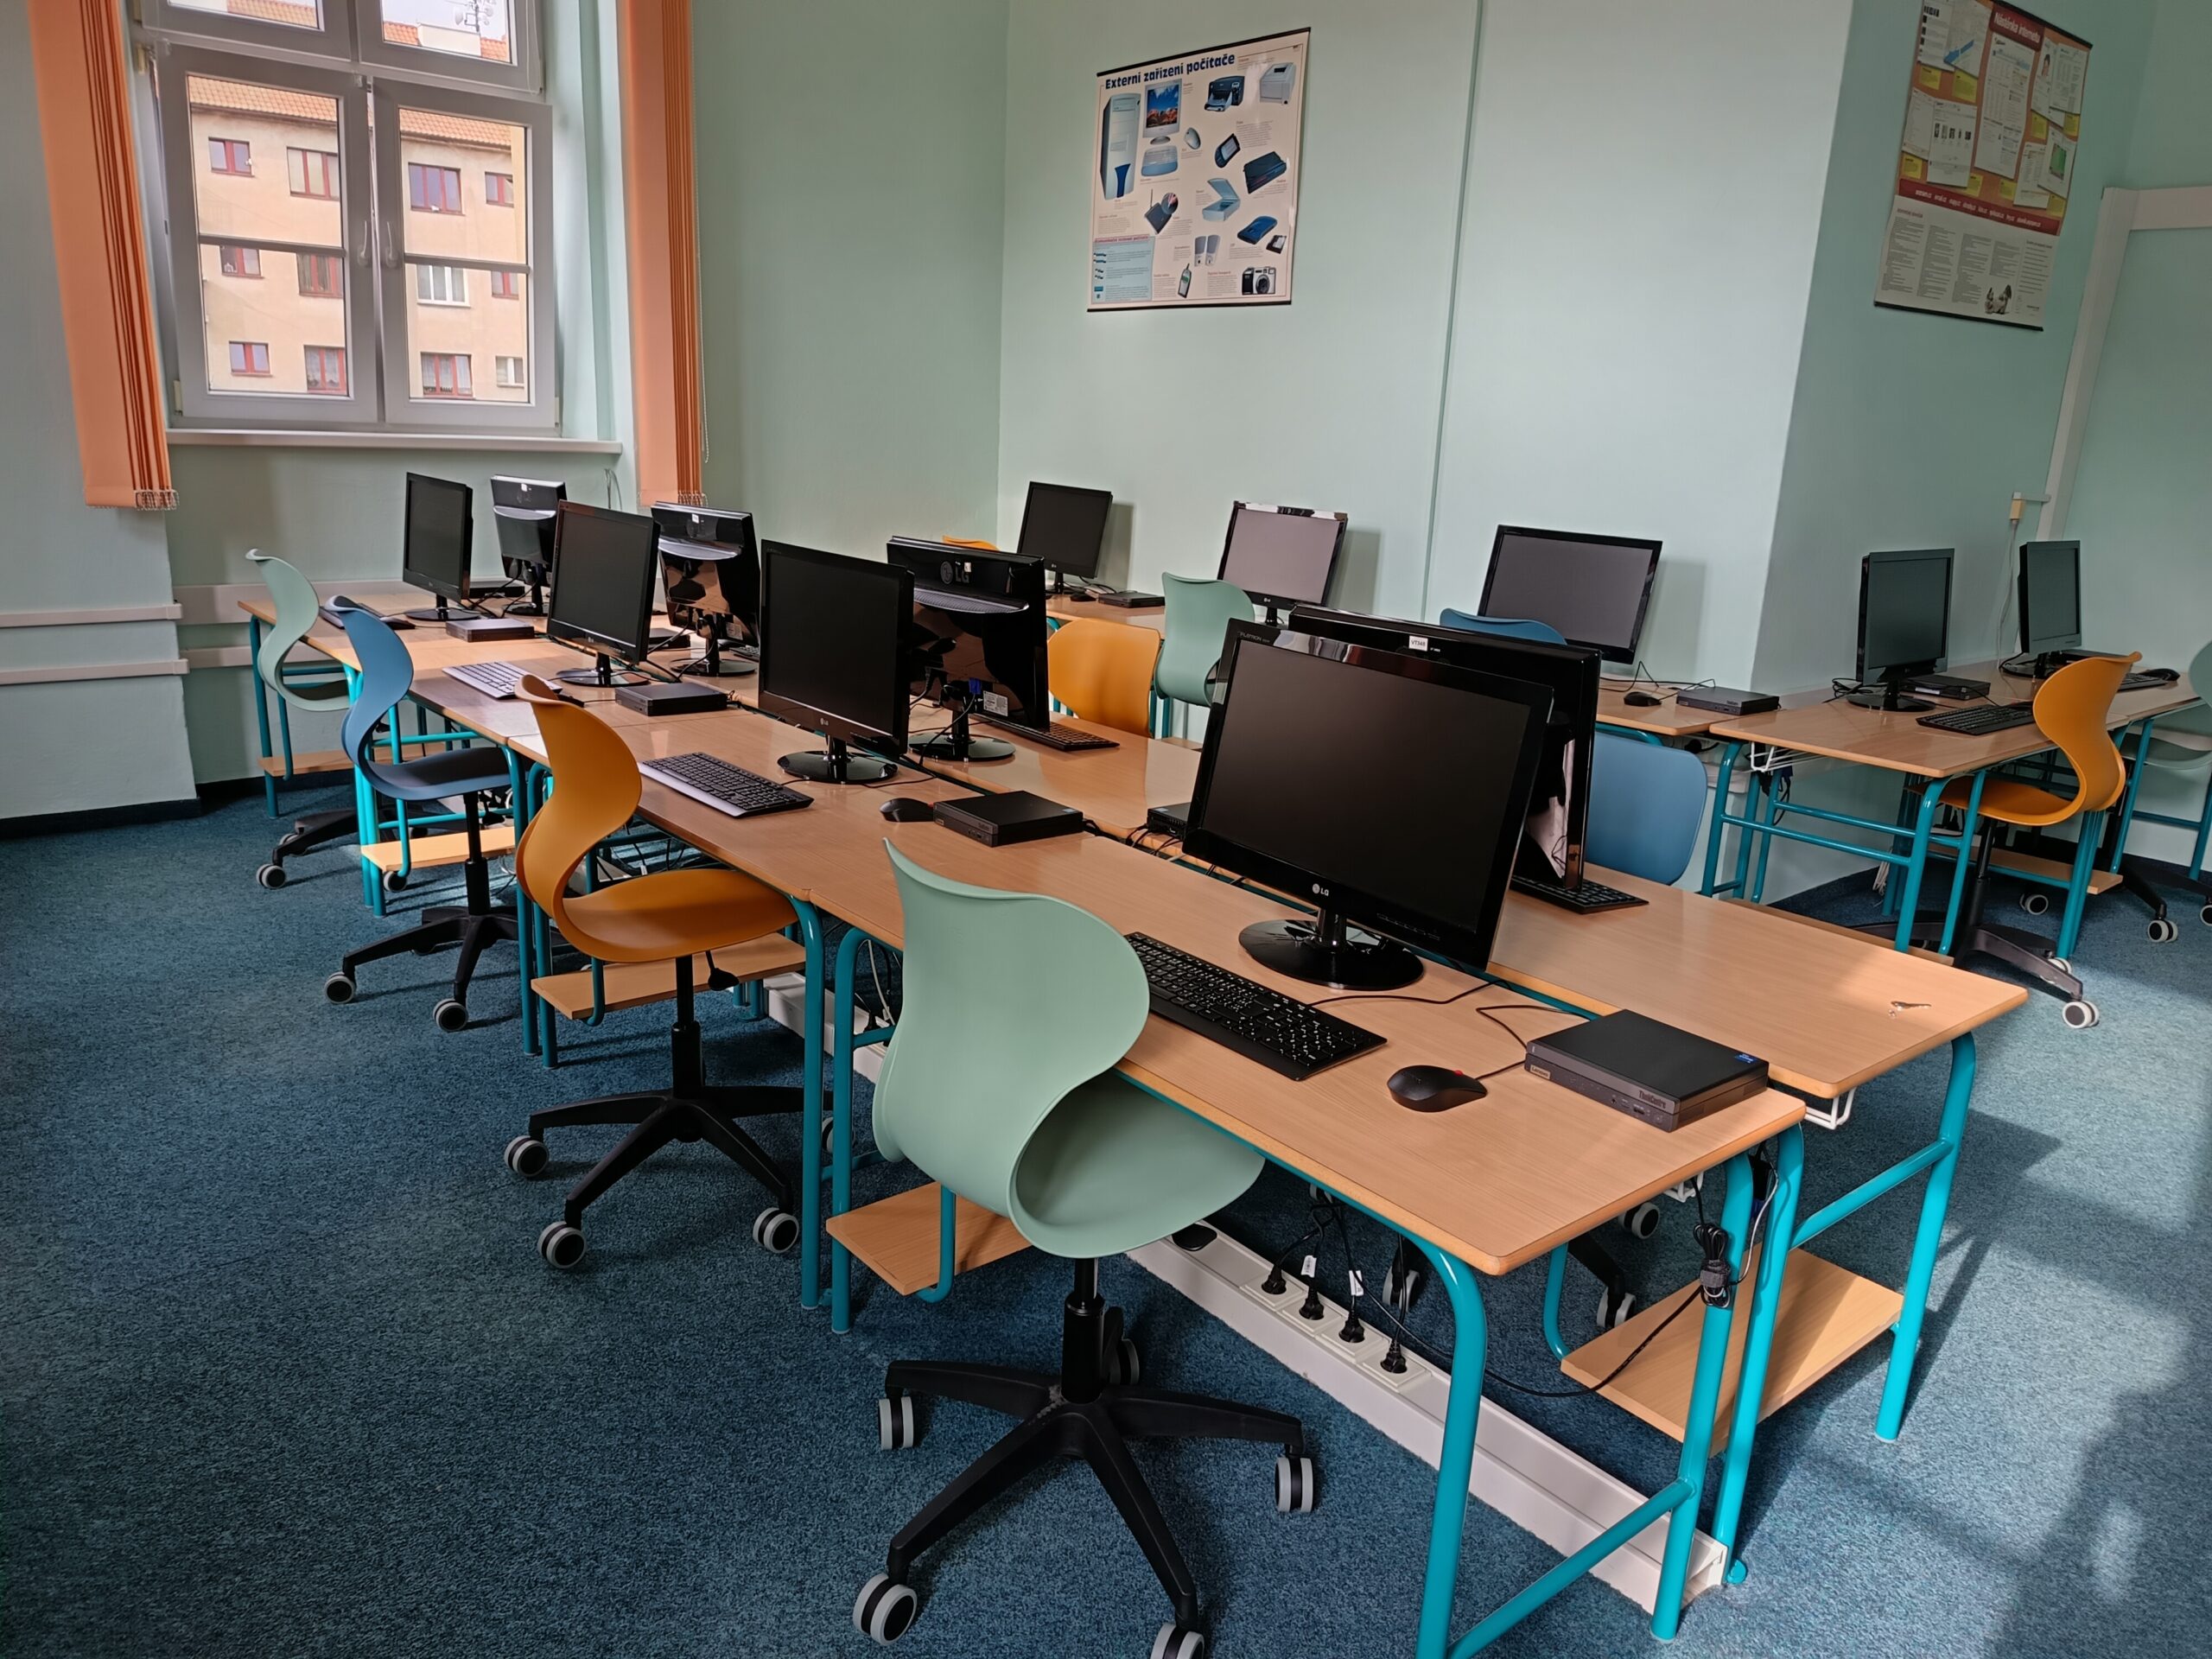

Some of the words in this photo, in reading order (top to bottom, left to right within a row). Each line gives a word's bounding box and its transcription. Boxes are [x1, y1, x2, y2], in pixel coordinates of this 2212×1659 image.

[1105, 72, 1141, 90] Externí
[1143, 63, 1184, 82] zařízení
[1186, 54, 1235, 75] počítače
